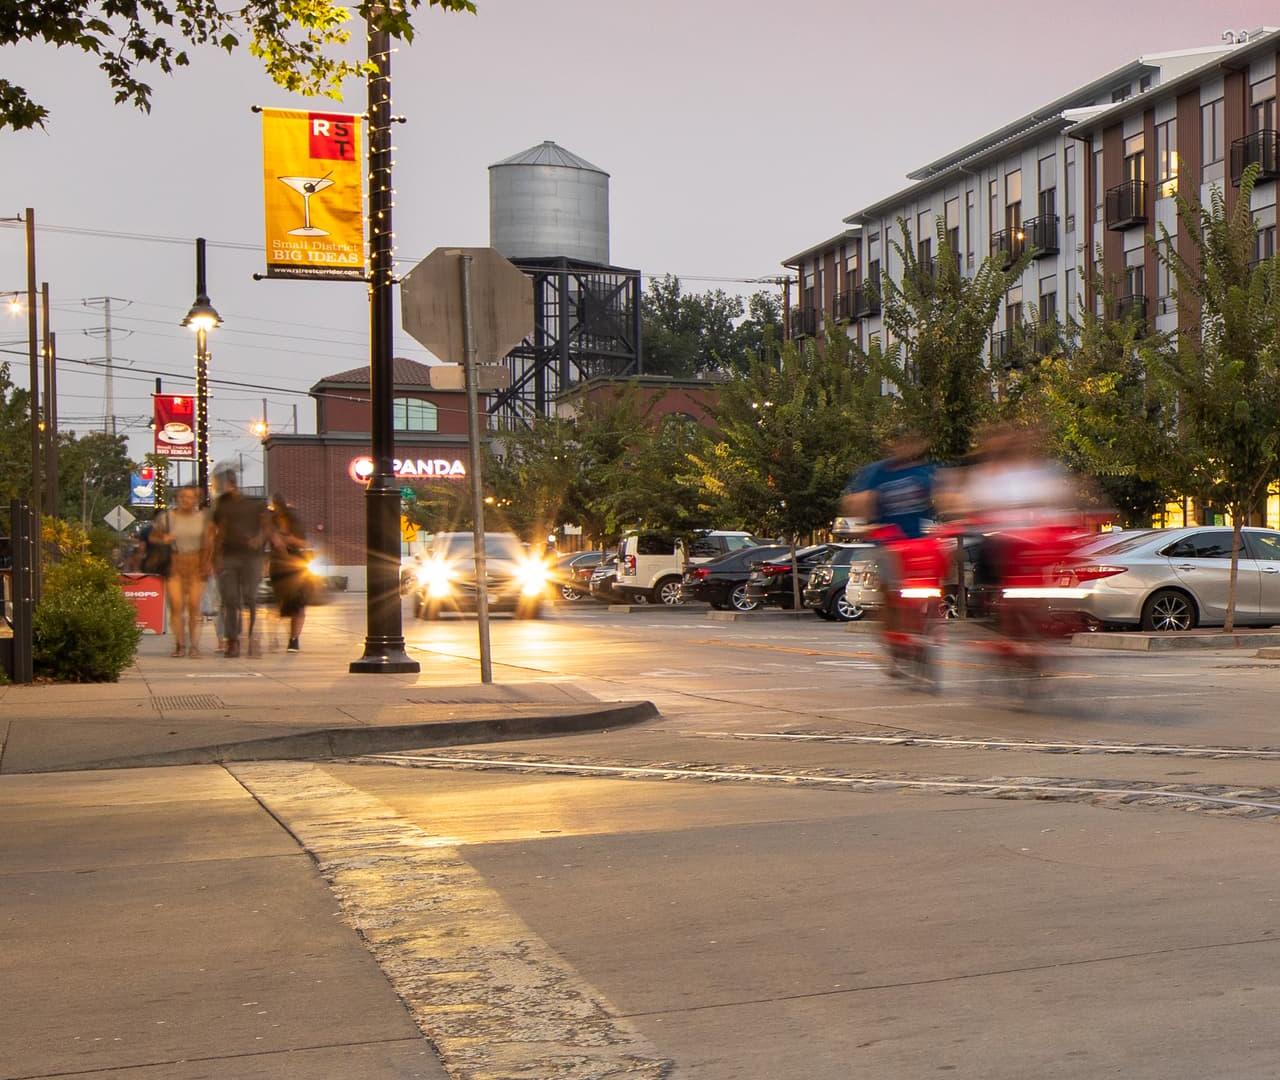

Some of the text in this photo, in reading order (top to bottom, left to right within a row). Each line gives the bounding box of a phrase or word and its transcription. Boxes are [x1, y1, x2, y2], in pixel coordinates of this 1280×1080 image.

[272, 239, 358, 252] Small District
[273, 250, 358, 264] BIG IDEAS
[392, 459, 466, 475] PANDA
